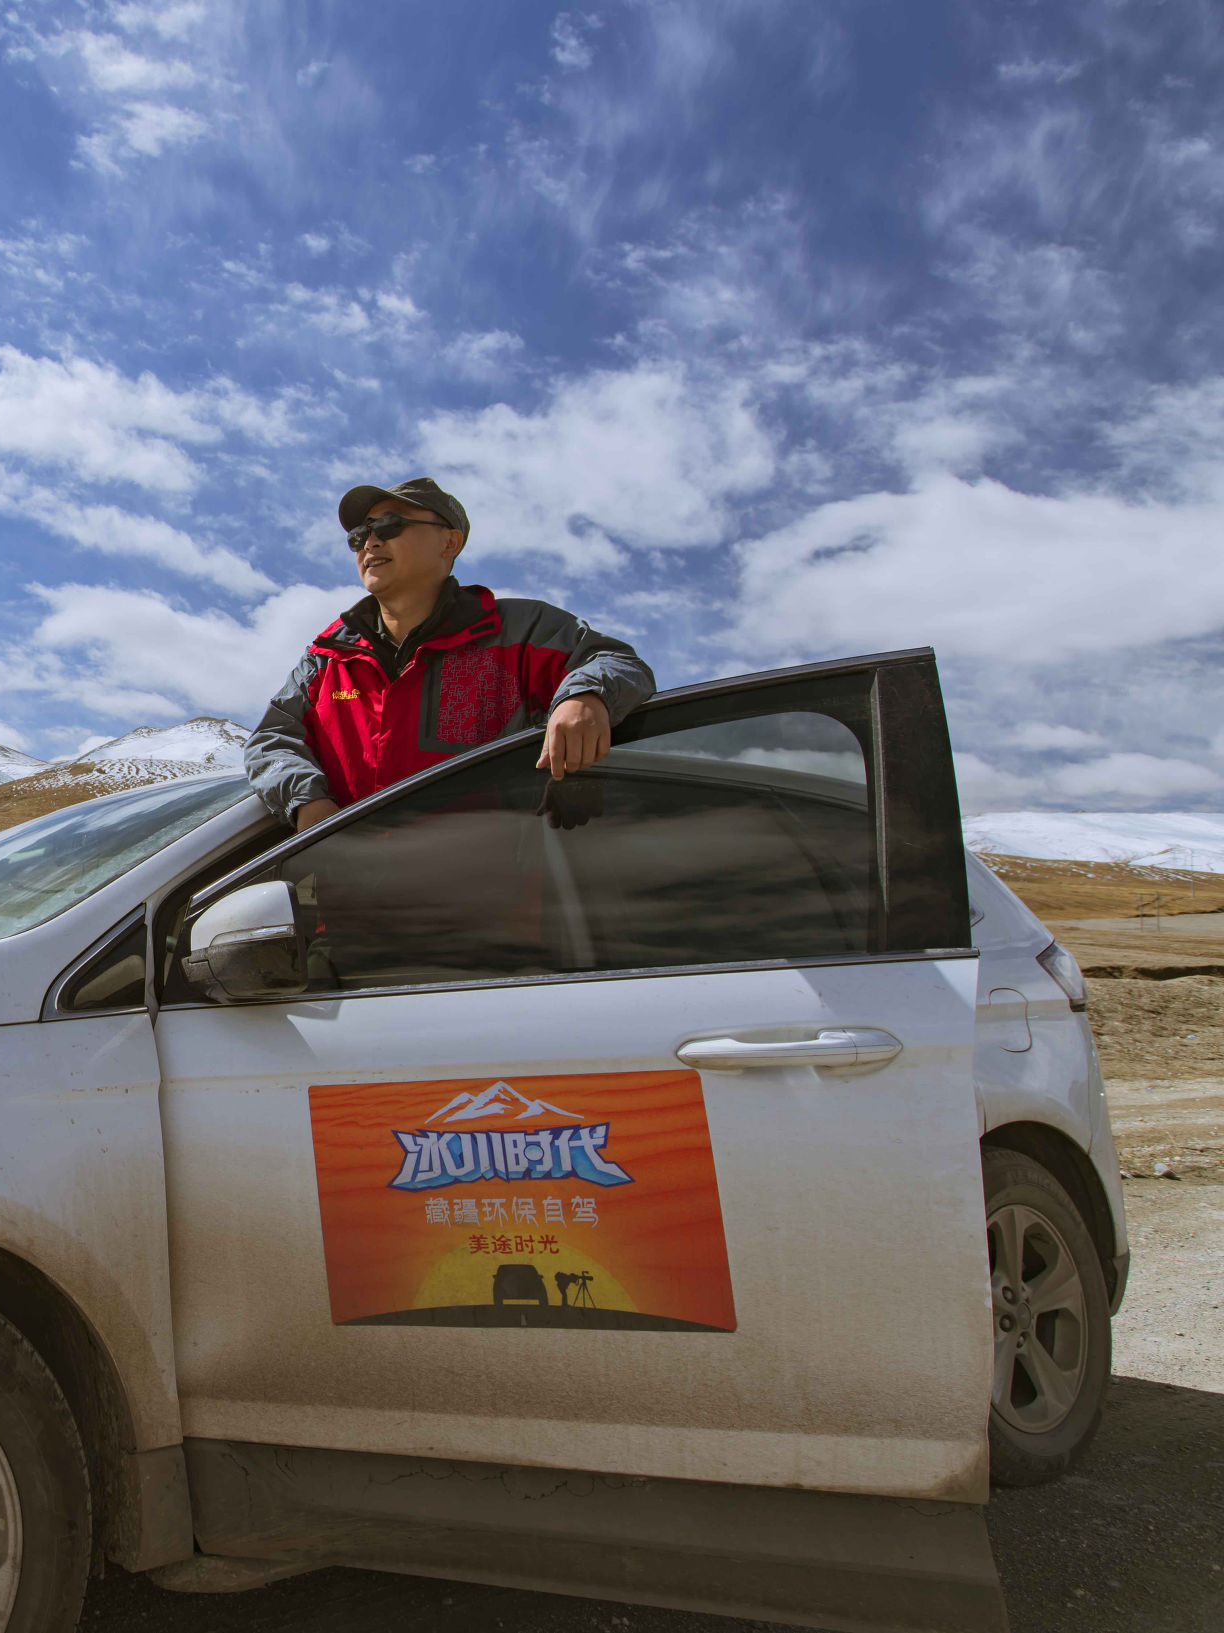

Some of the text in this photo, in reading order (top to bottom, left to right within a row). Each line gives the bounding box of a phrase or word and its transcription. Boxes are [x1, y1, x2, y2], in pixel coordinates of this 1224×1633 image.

[387, 1123, 635, 1192] 冰川时代
[424, 1196, 599, 1229] 藏疆环保自驾
[468, 1234, 560, 1255] 美途时光
